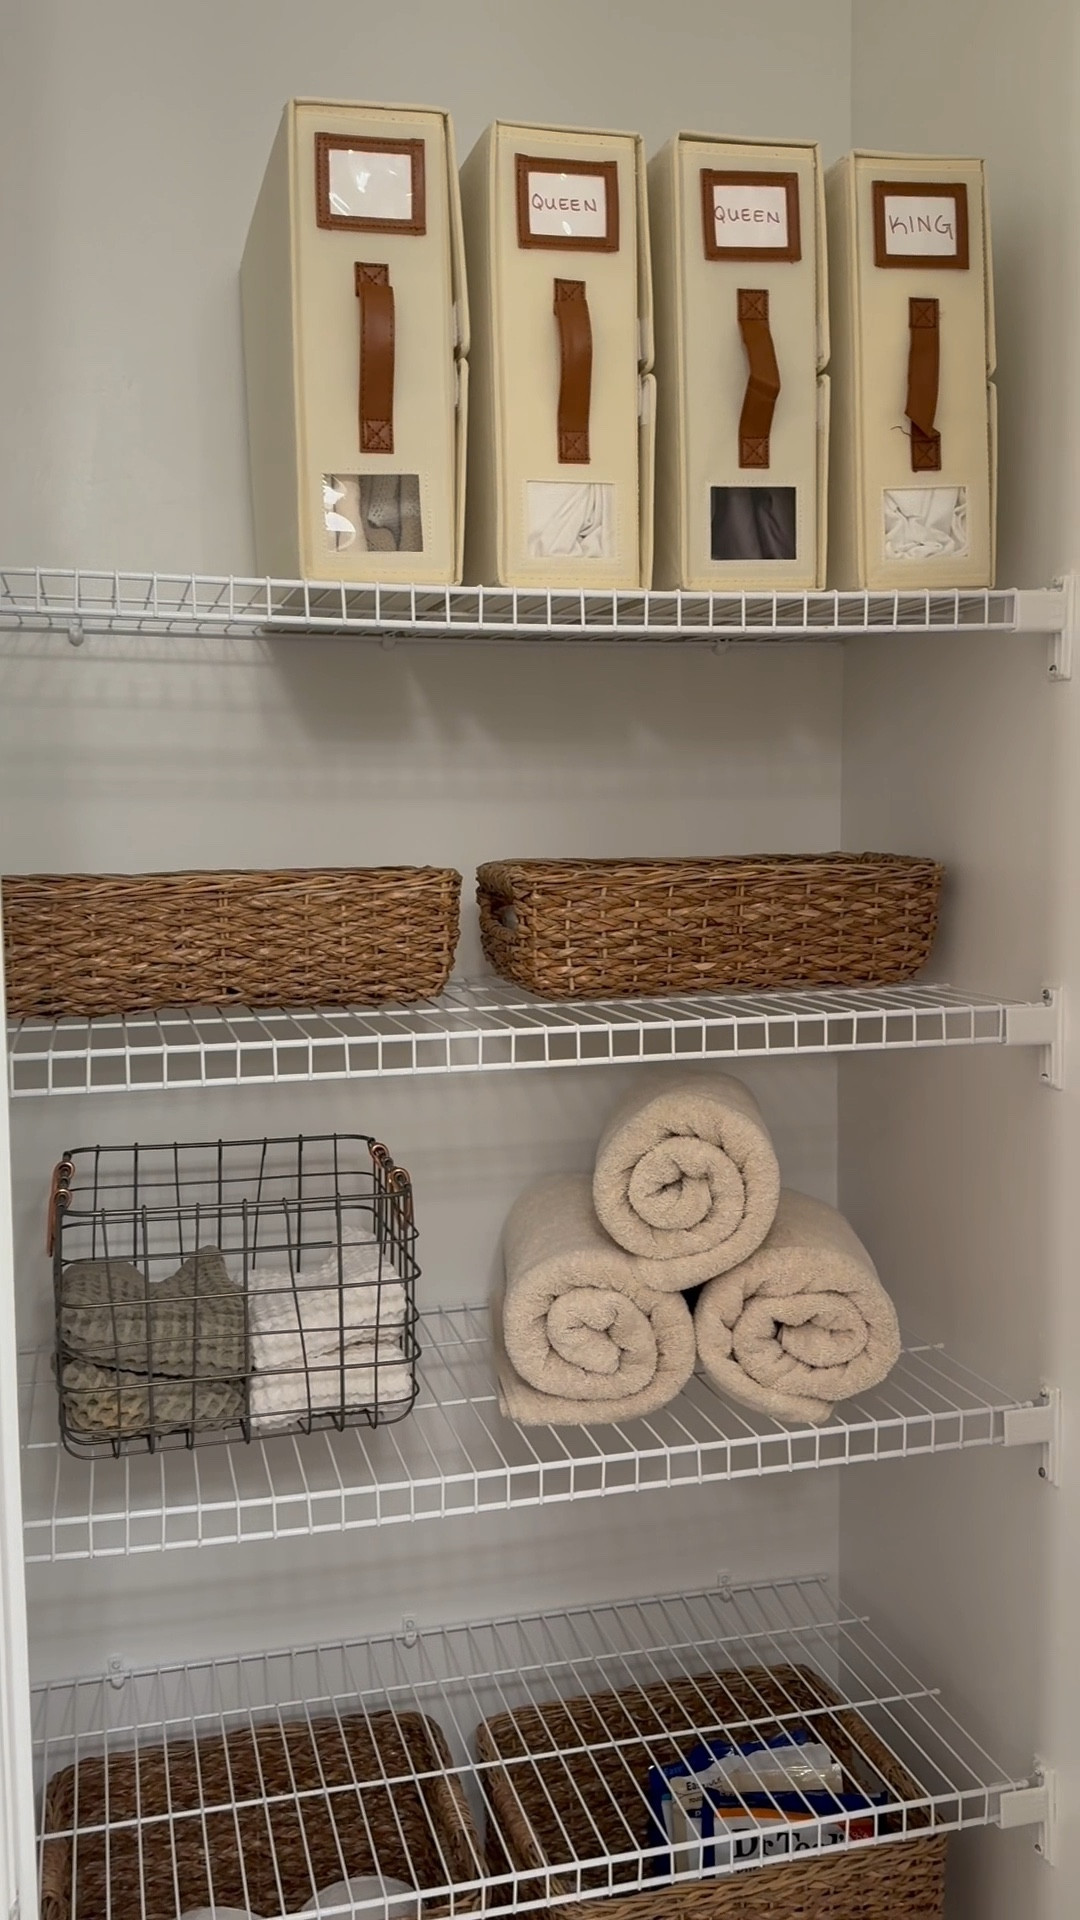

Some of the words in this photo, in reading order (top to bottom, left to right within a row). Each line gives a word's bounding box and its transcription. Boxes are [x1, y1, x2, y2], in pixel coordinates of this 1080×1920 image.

[532, 193, 597, 212] QUEEN
[715, 205, 780, 224] QUEEN
[889, 215, 953, 240] KING
[732, 1828, 774, 1858] Dr
